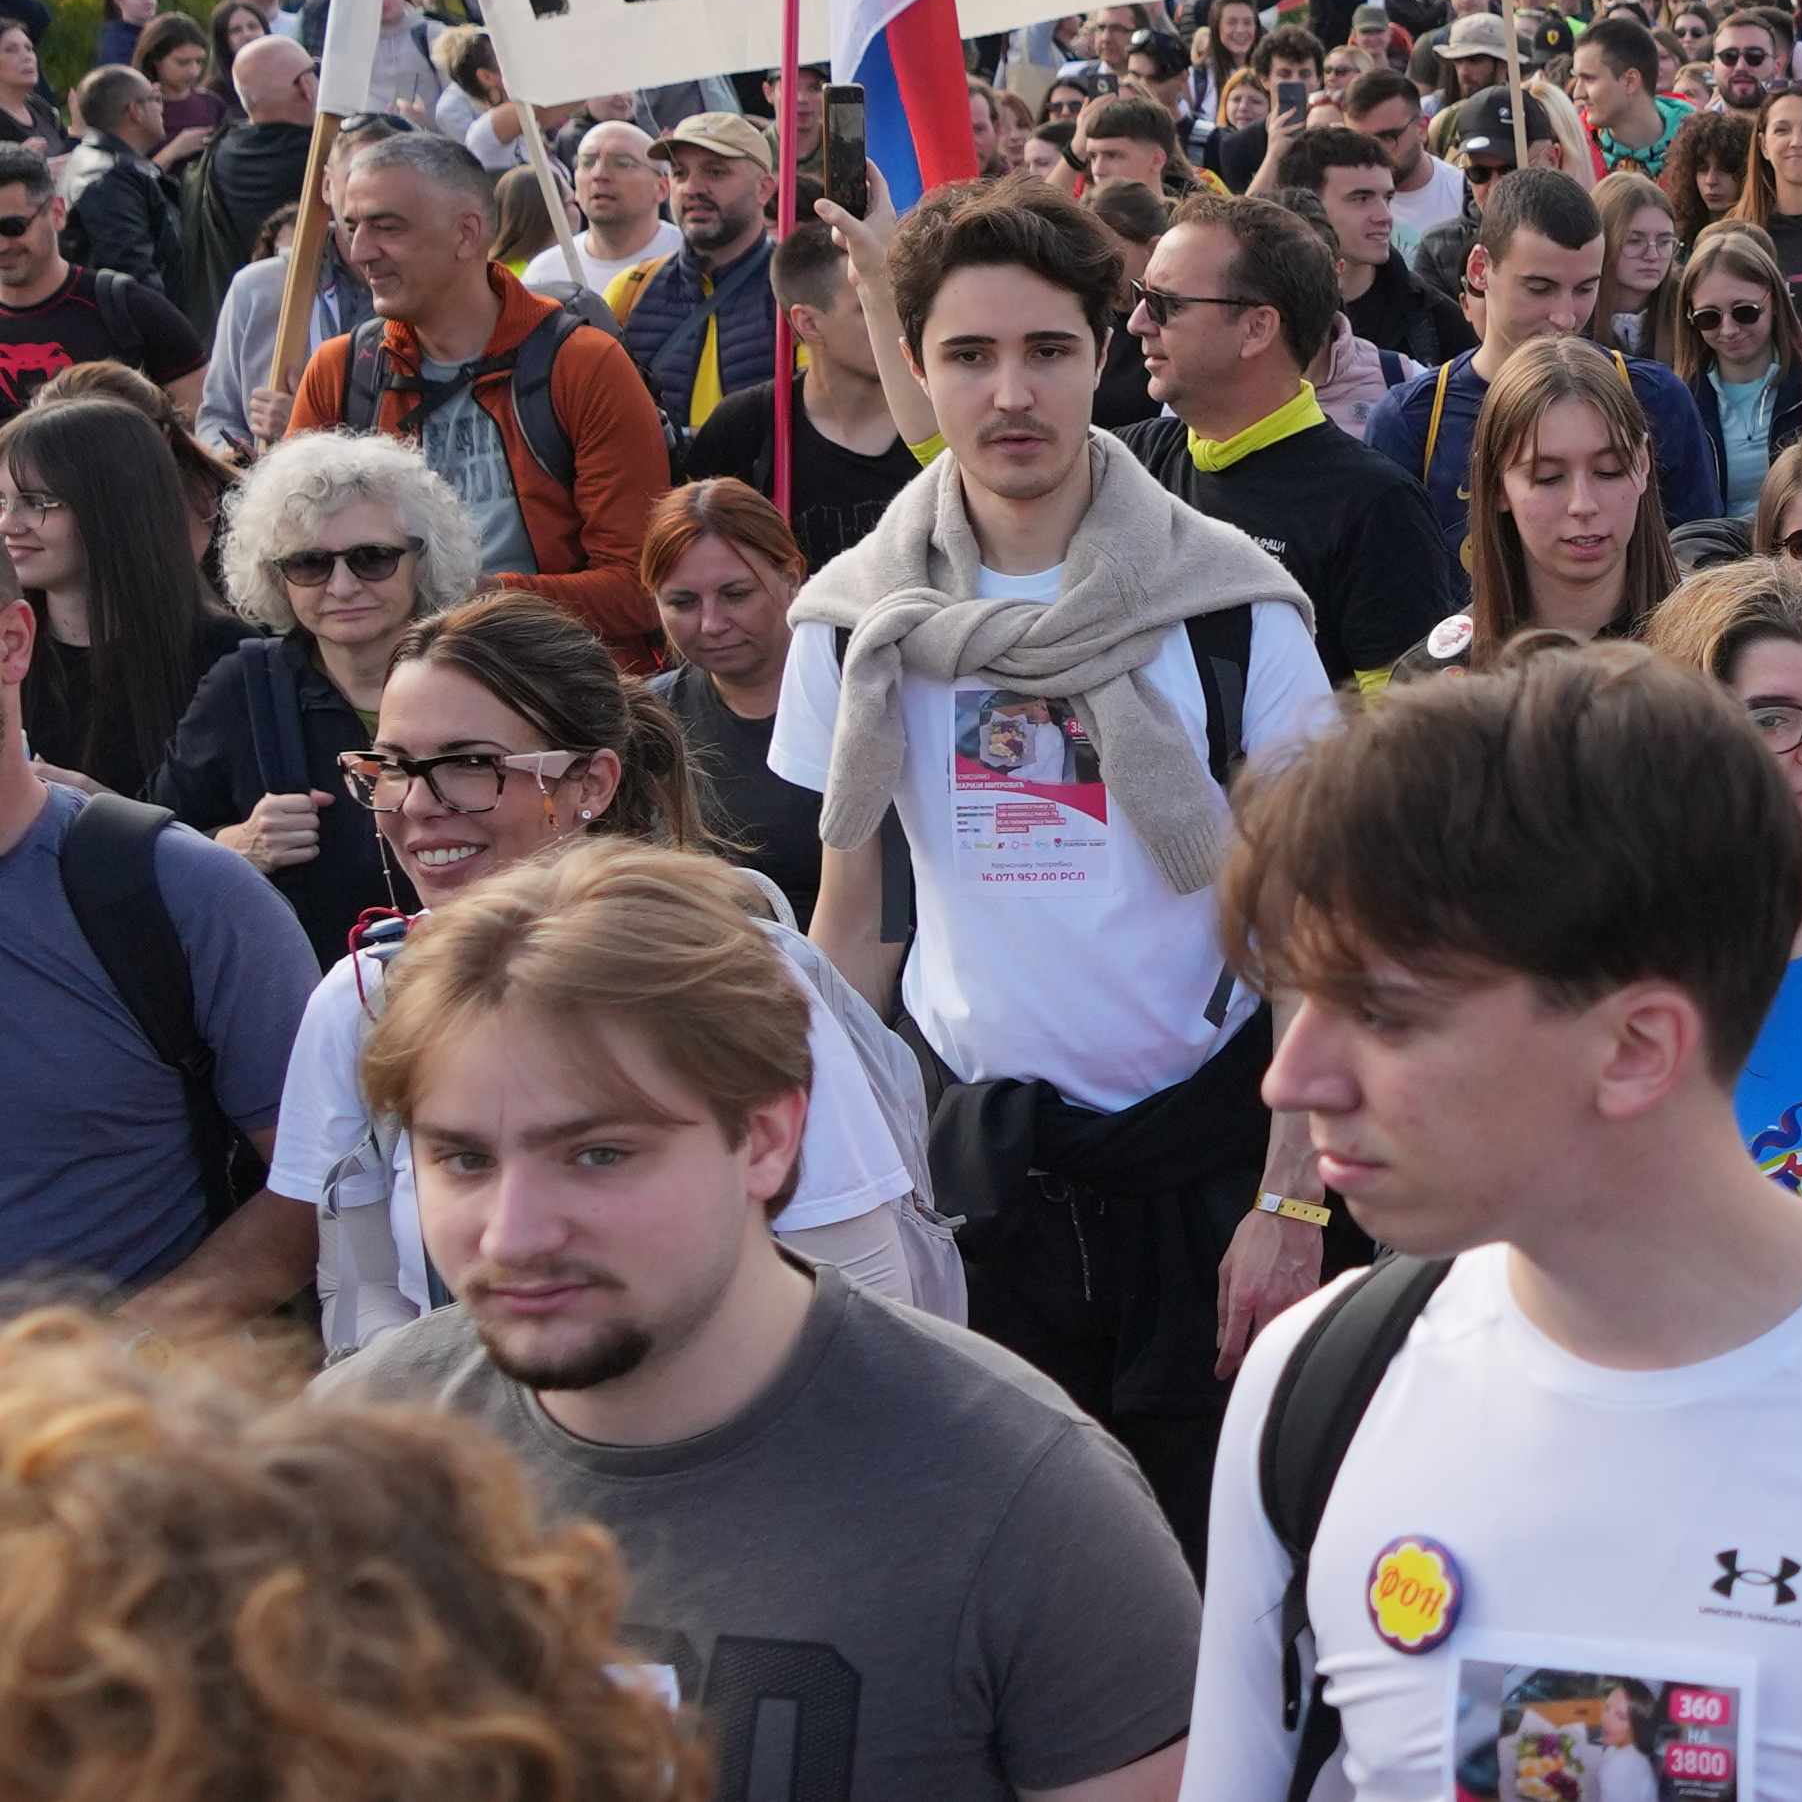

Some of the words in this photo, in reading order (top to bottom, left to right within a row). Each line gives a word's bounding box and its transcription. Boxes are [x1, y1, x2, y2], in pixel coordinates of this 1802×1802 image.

[1378, 1564, 1446, 1620] ФОН
[1678, 1694, 1722, 1723] 360
[1670, 1747, 1727, 1779] 3800
